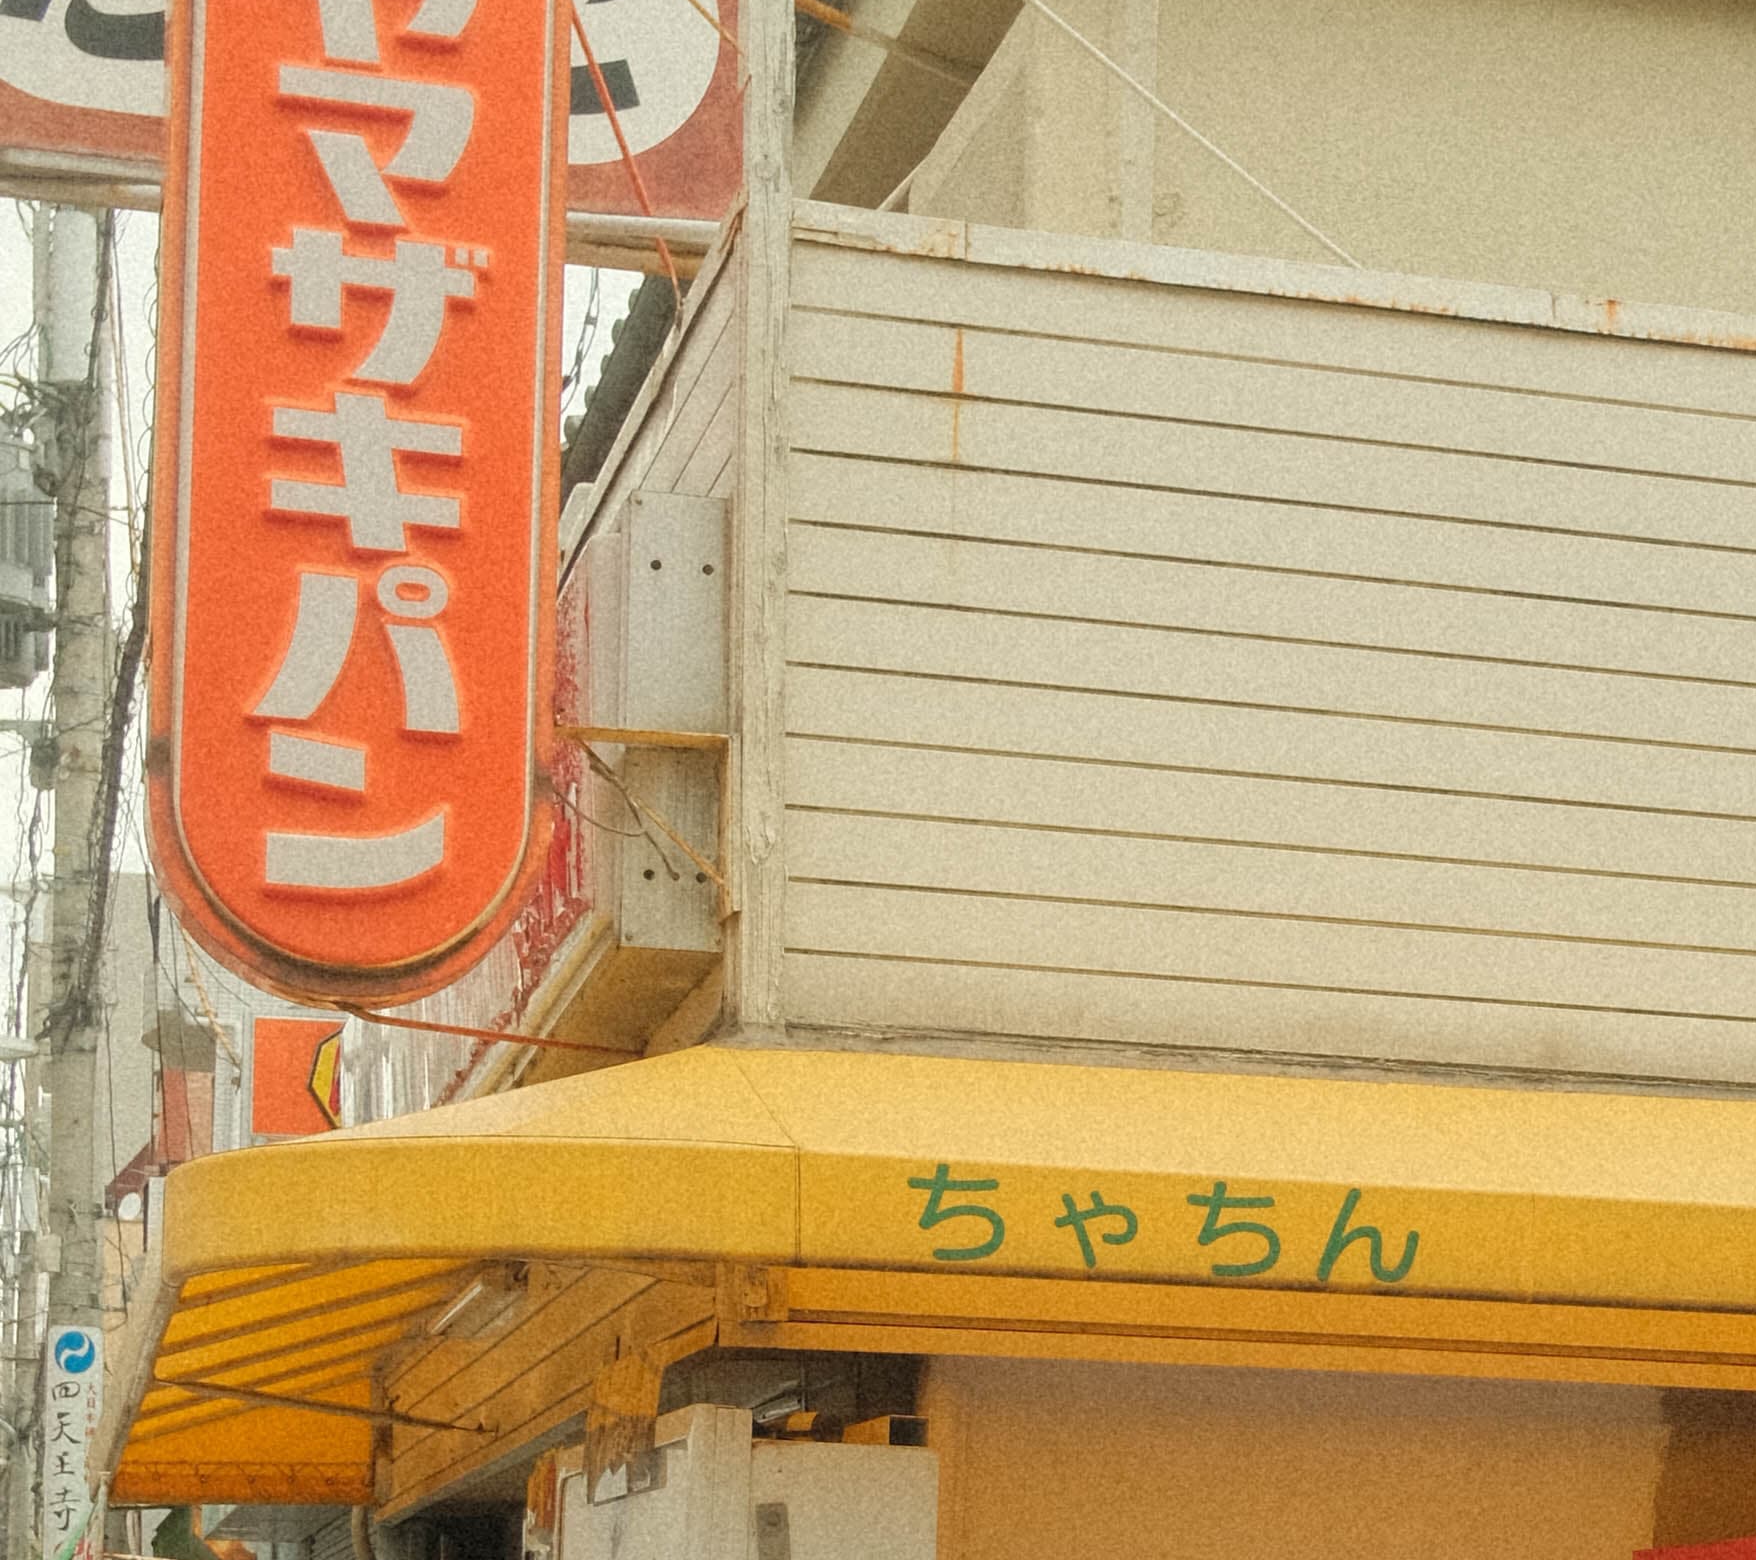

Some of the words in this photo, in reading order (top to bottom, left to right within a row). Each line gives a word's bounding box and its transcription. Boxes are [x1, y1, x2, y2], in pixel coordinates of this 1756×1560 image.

[908, 1163, 1420, 1283] ちゃちん
[50, 1380, 82, 1531] 四天王寺
